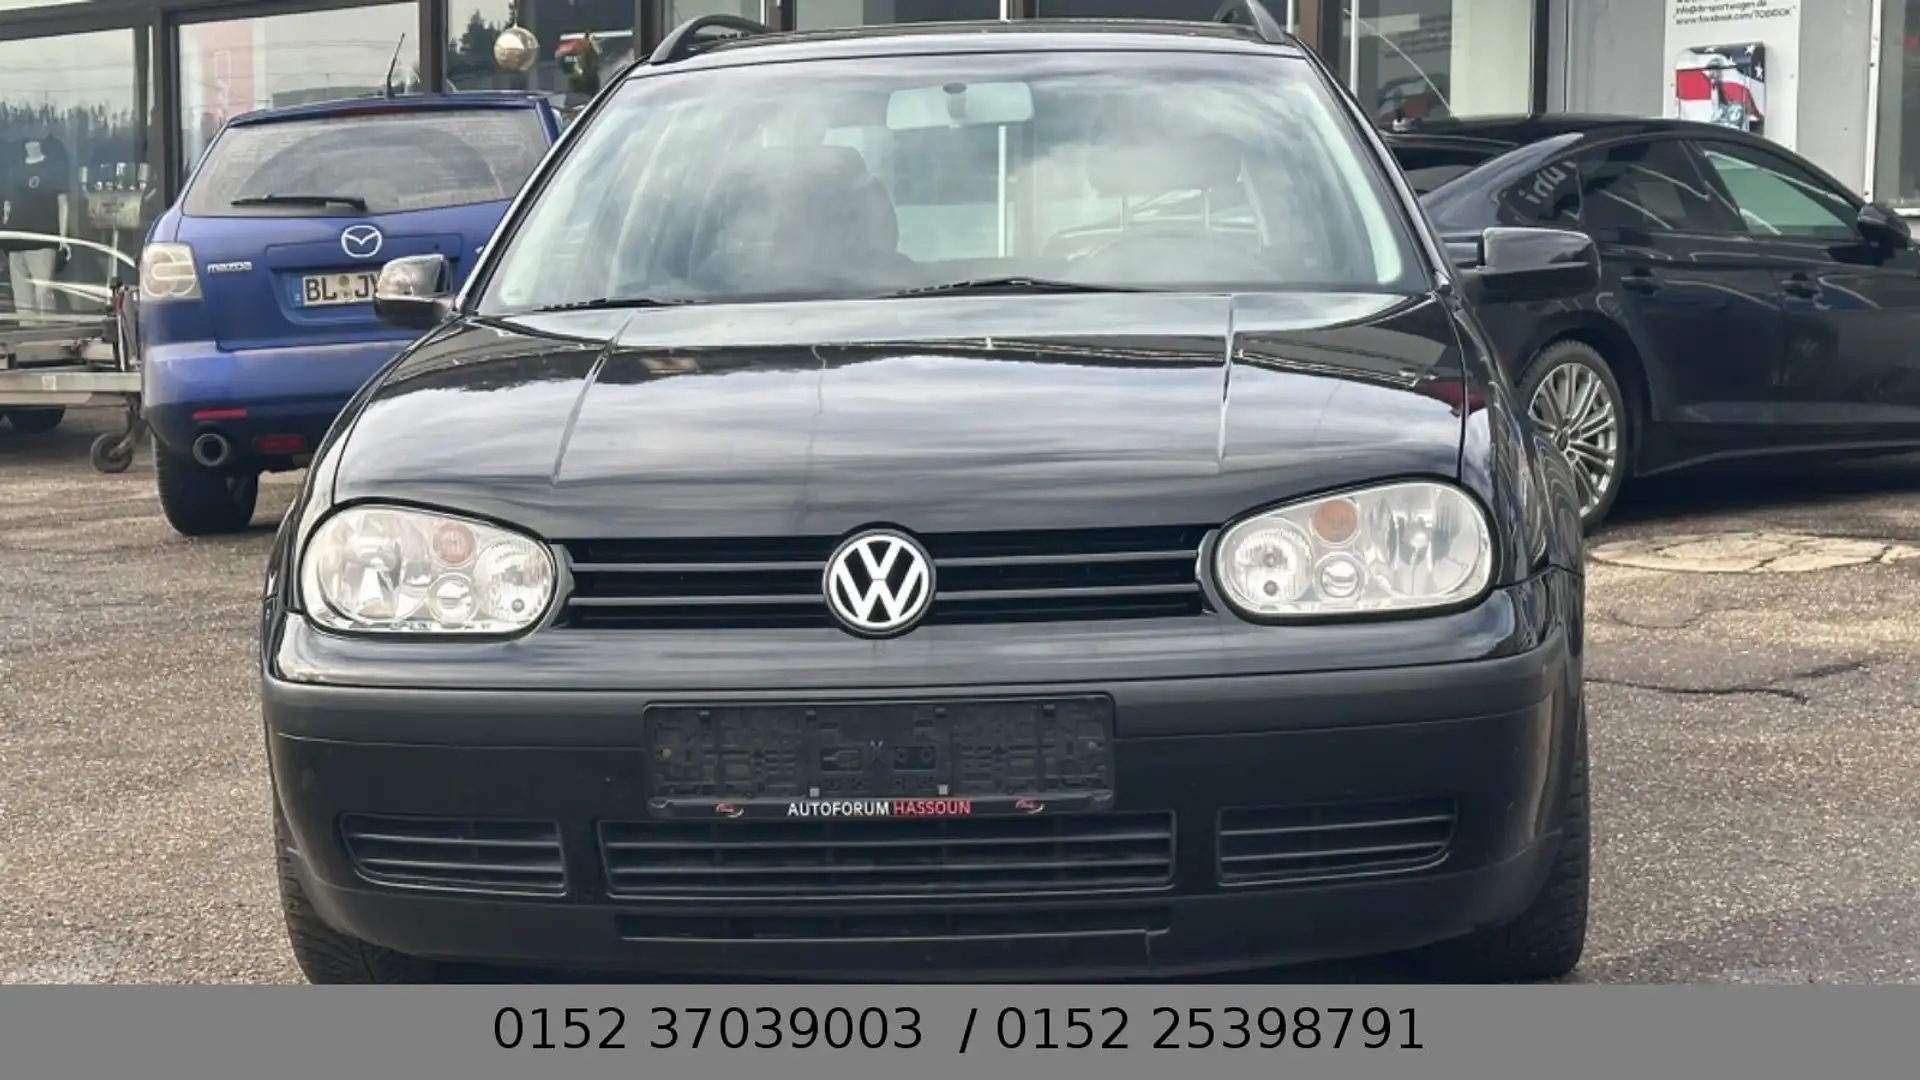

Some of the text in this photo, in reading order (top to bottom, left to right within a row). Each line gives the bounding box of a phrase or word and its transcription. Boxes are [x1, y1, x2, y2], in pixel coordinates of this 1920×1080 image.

[207, 261, 252, 274] mazda
[306, 278, 337, 301] BL
[829, 535, 929, 628] VW
[787, 800, 971, 816] AUTOFORUM HASSOUN
